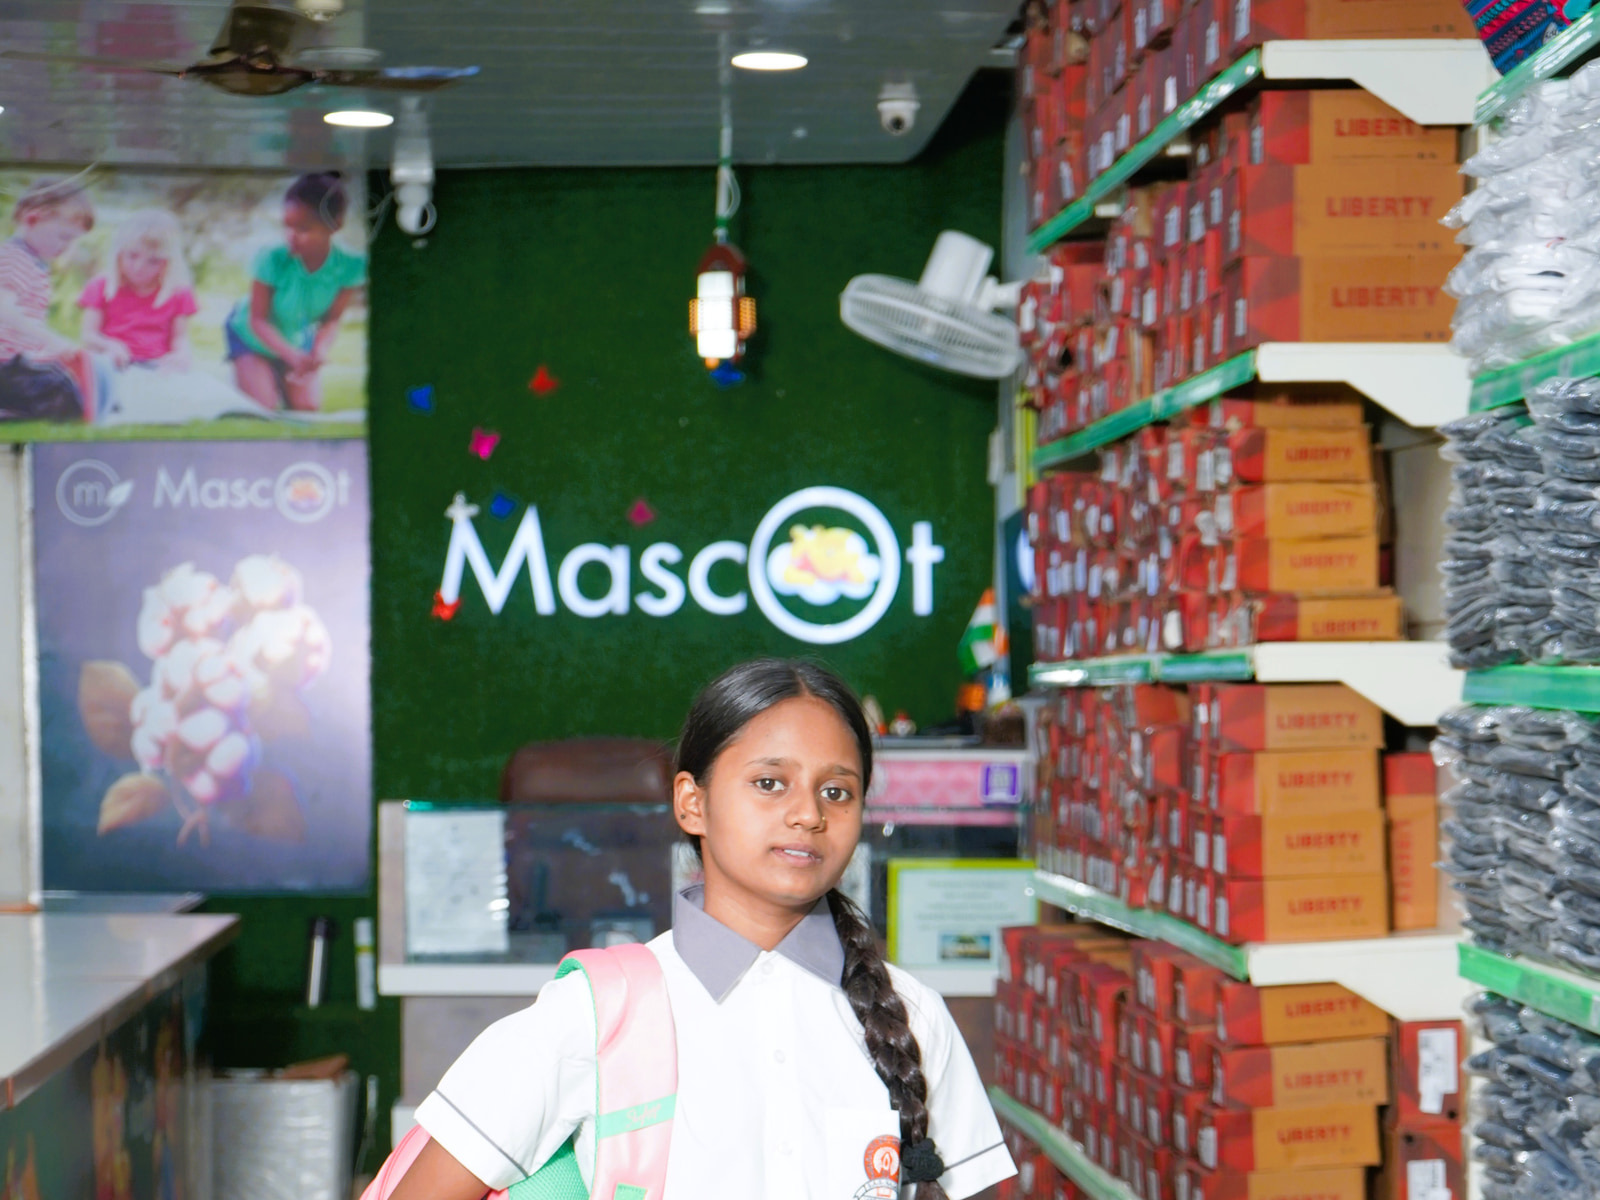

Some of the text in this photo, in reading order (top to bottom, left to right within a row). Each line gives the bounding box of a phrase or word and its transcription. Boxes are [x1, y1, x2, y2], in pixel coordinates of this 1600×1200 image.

[1325, 196, 1435, 217] LIBERTY
[1332, 286, 1441, 308] LIBERTY
[1286, 446, 1353, 462] LIBERTY
[1276, 712, 1358, 730] LIBERTY
[1278, 771, 1353, 788] LIBERTY
[1285, 832, 1360, 849] LIBERTY
[1287, 897, 1361, 915] LIBERTY
[1285, 996, 1361, 1018] LIBERTY
[1283, 1069, 1364, 1090] LIBERTY
[1277, 1125, 1350, 1145] LIBERTY
